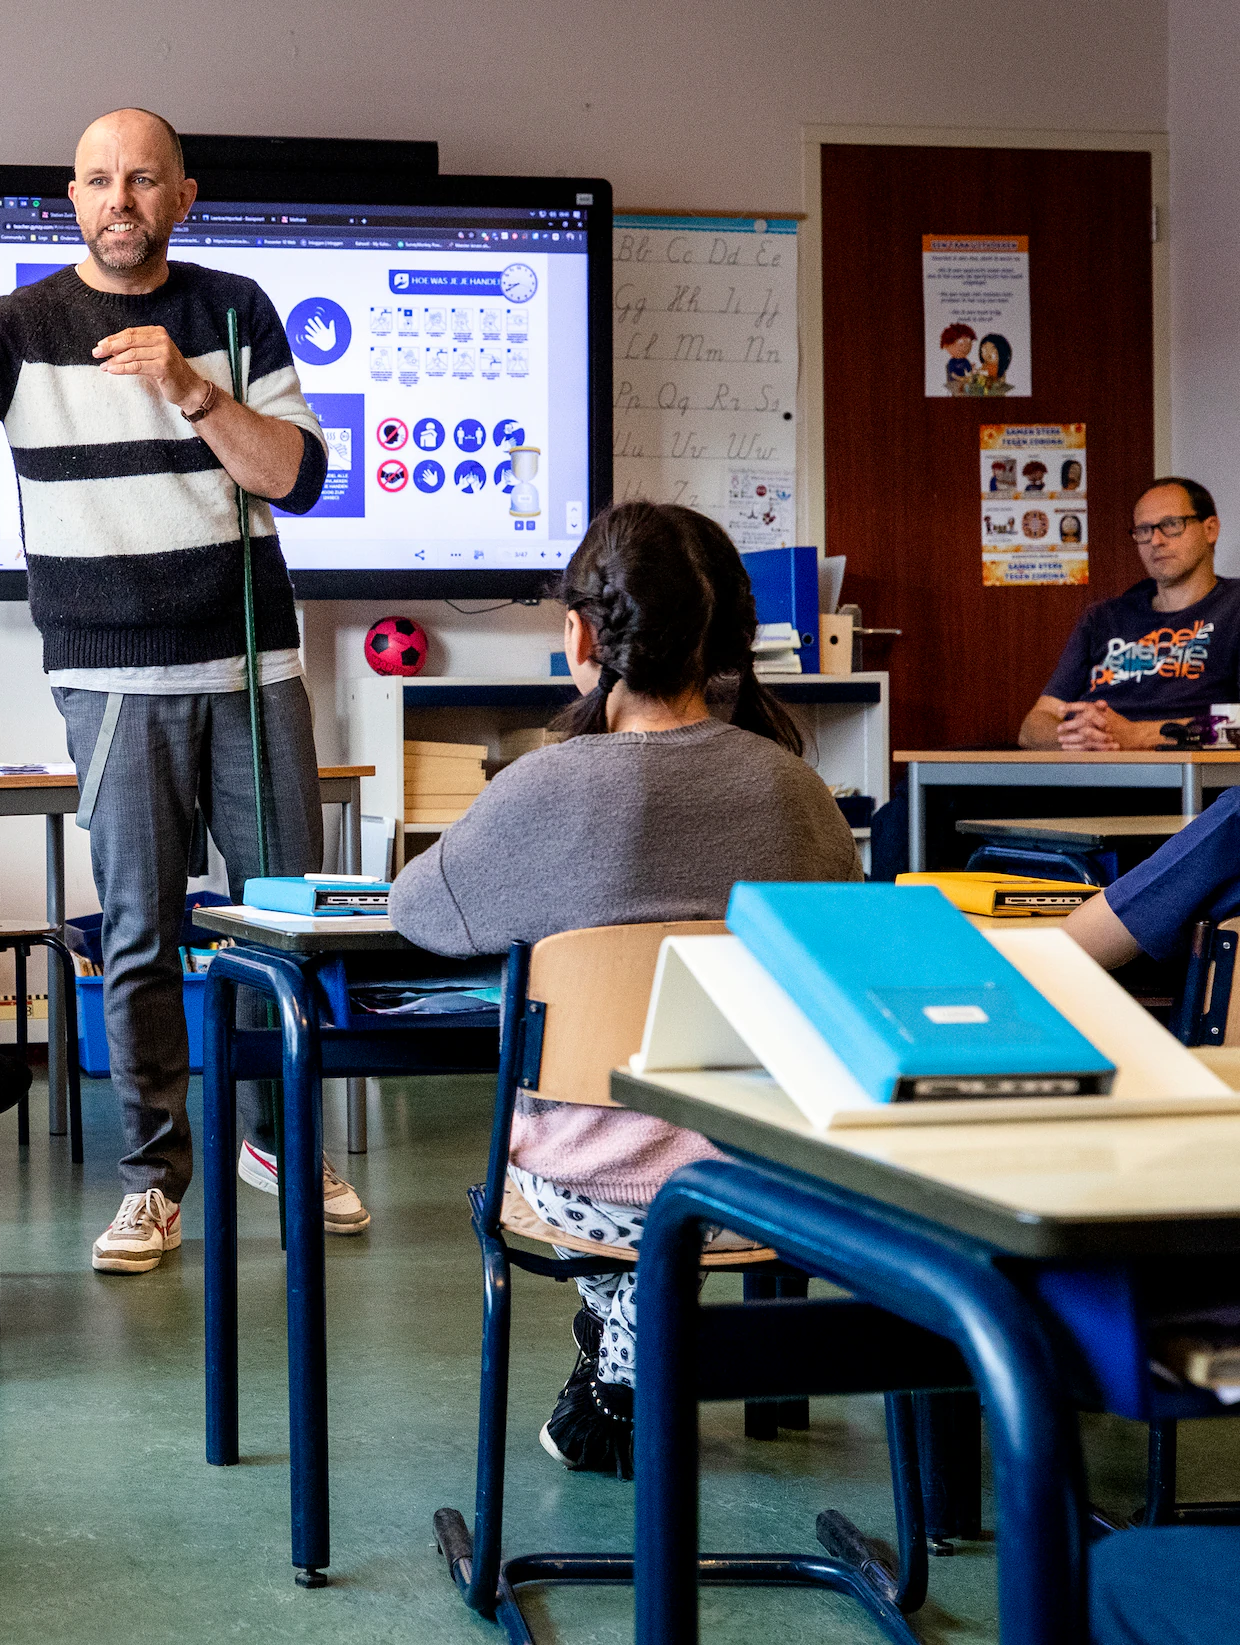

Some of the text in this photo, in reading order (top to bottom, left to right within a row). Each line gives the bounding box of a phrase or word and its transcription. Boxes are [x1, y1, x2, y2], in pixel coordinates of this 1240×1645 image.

[411, 276, 428, 285] HOE
[430, 277, 448, 285] WAS
[450, 277, 458, 285] JE
[460, 277, 468, 286] JE
